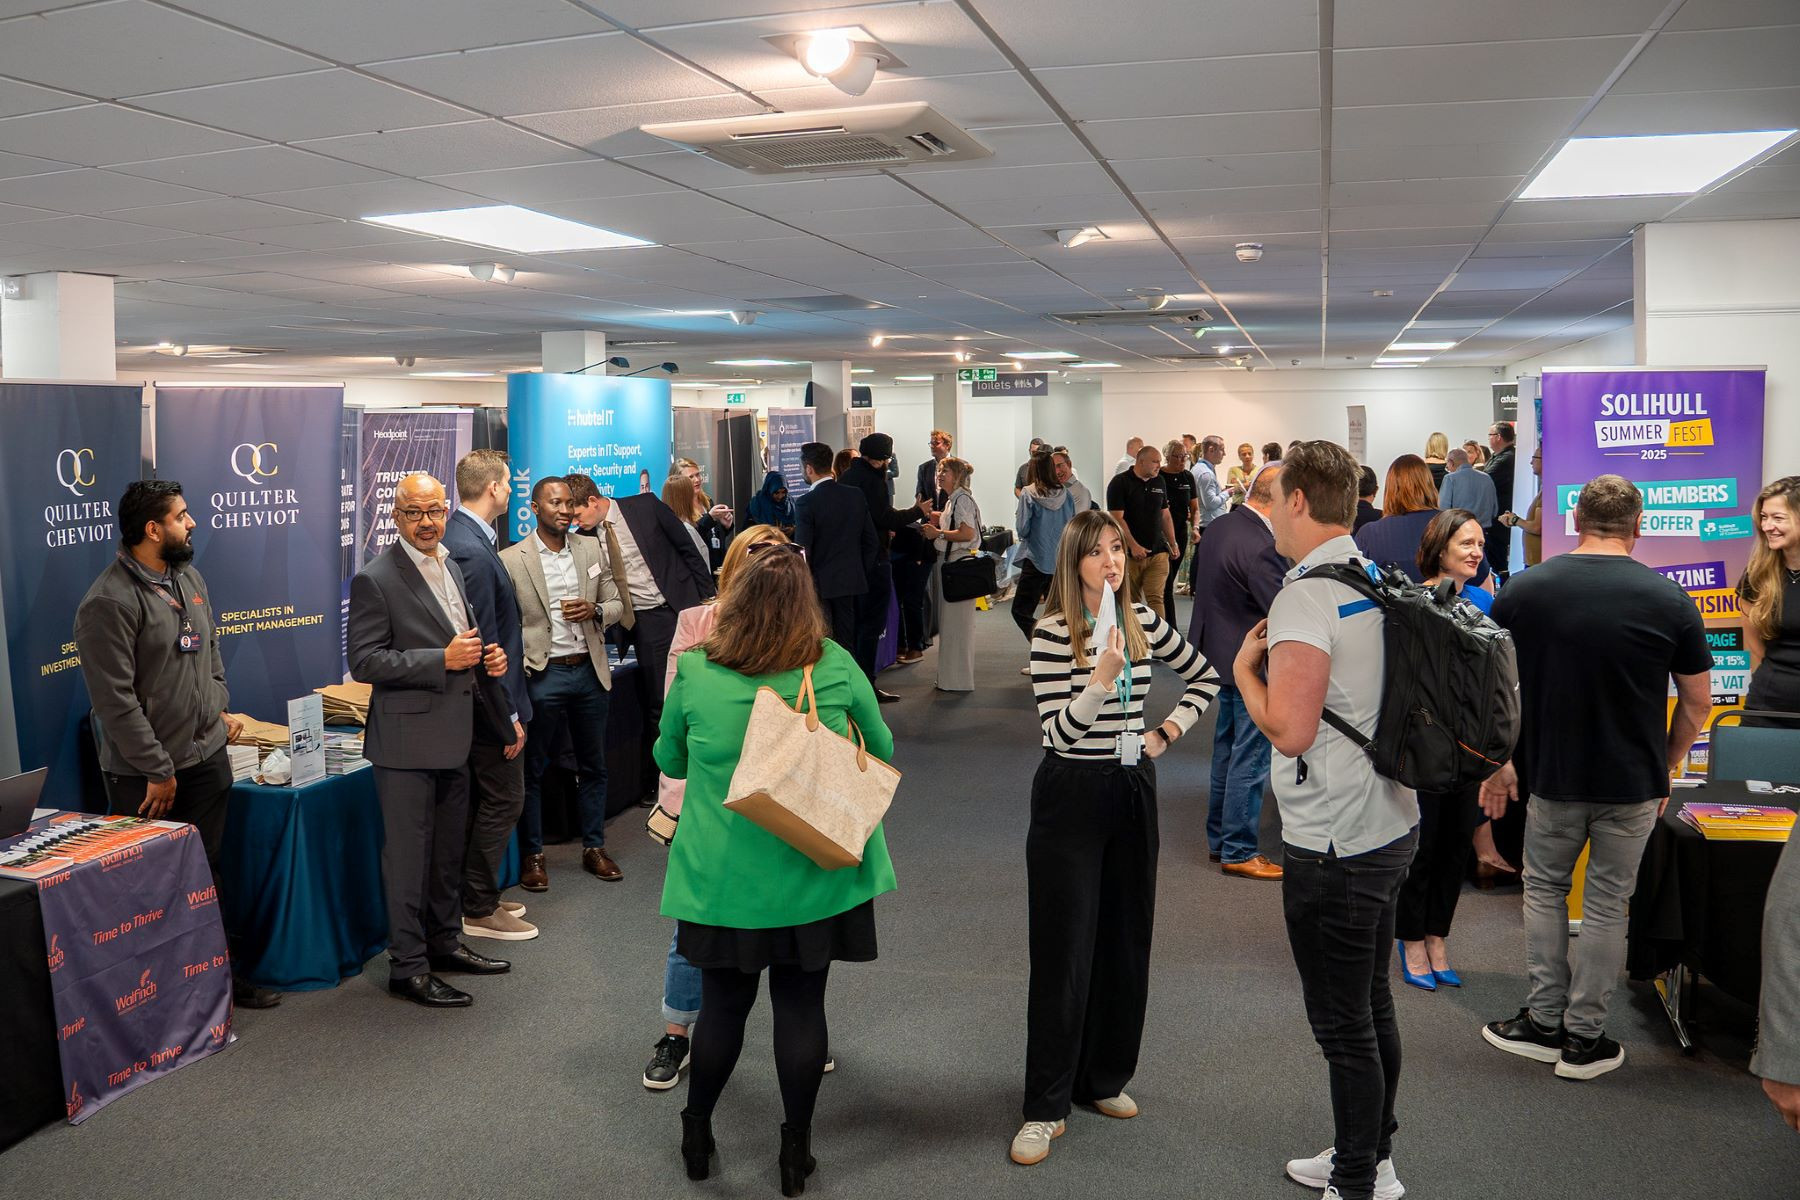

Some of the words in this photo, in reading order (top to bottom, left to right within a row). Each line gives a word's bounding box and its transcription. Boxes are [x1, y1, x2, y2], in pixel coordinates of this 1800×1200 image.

[977, 381, 1011, 390] Toilets
[1600, 393, 1708, 416] SOLIHULL
[576, 409, 604, 426] hubtel
[606, 410, 615, 425] IT
[373, 429, 408, 440] Headpoint
[1601, 424, 1662, 441] SUMMER
[1673, 426, 1703, 442] FEST
[567, 446, 597, 461] Experts
[597, 445, 605, 457] in
[606, 444, 613, 456] IT
[613, 443, 642, 459] Support,
[1640, 449, 1667, 460] 2025
[593, 463, 623, 479] Security
[623, 461, 636, 474] and
[210, 488, 300, 512] QUILTER
[1649, 485, 1729, 505] MEMBERS
[44, 500, 113, 527] QUILTER
[210, 509, 300, 529] CHEVIOT
[1650, 515, 1693, 530] OFFER
[46, 523, 113, 548] CHEVIOT
[1660, 567, 1716, 587] AZINE
[221, 607, 281, 622] SPECIALISTS
[283, 605, 294, 615] IN
[256, 614, 324, 631] MANAGEMENT
[1705, 633, 1737, 647] PAGE
[1725, 655, 1746, 666] 15%
[1712, 678, 1719, 687] +
[1721, 675, 1745, 689] VAT
[1725, 696, 1737, 704] VAT
[39, 870, 71, 890] Thrive
[93, 928, 118, 946] Time
[120, 920, 132, 935] to
[133, 909, 164, 929] Thrive
[183, 961, 209, 978] Time
[212, 955, 224, 968] to
[115, 981, 157, 1011] Walfinch
[62, 1017, 85, 1040] Thrive
[107, 1065, 131, 1088] Time
[134, 1061, 147, 1073] to
[151, 1044, 183, 1067] Thrive
